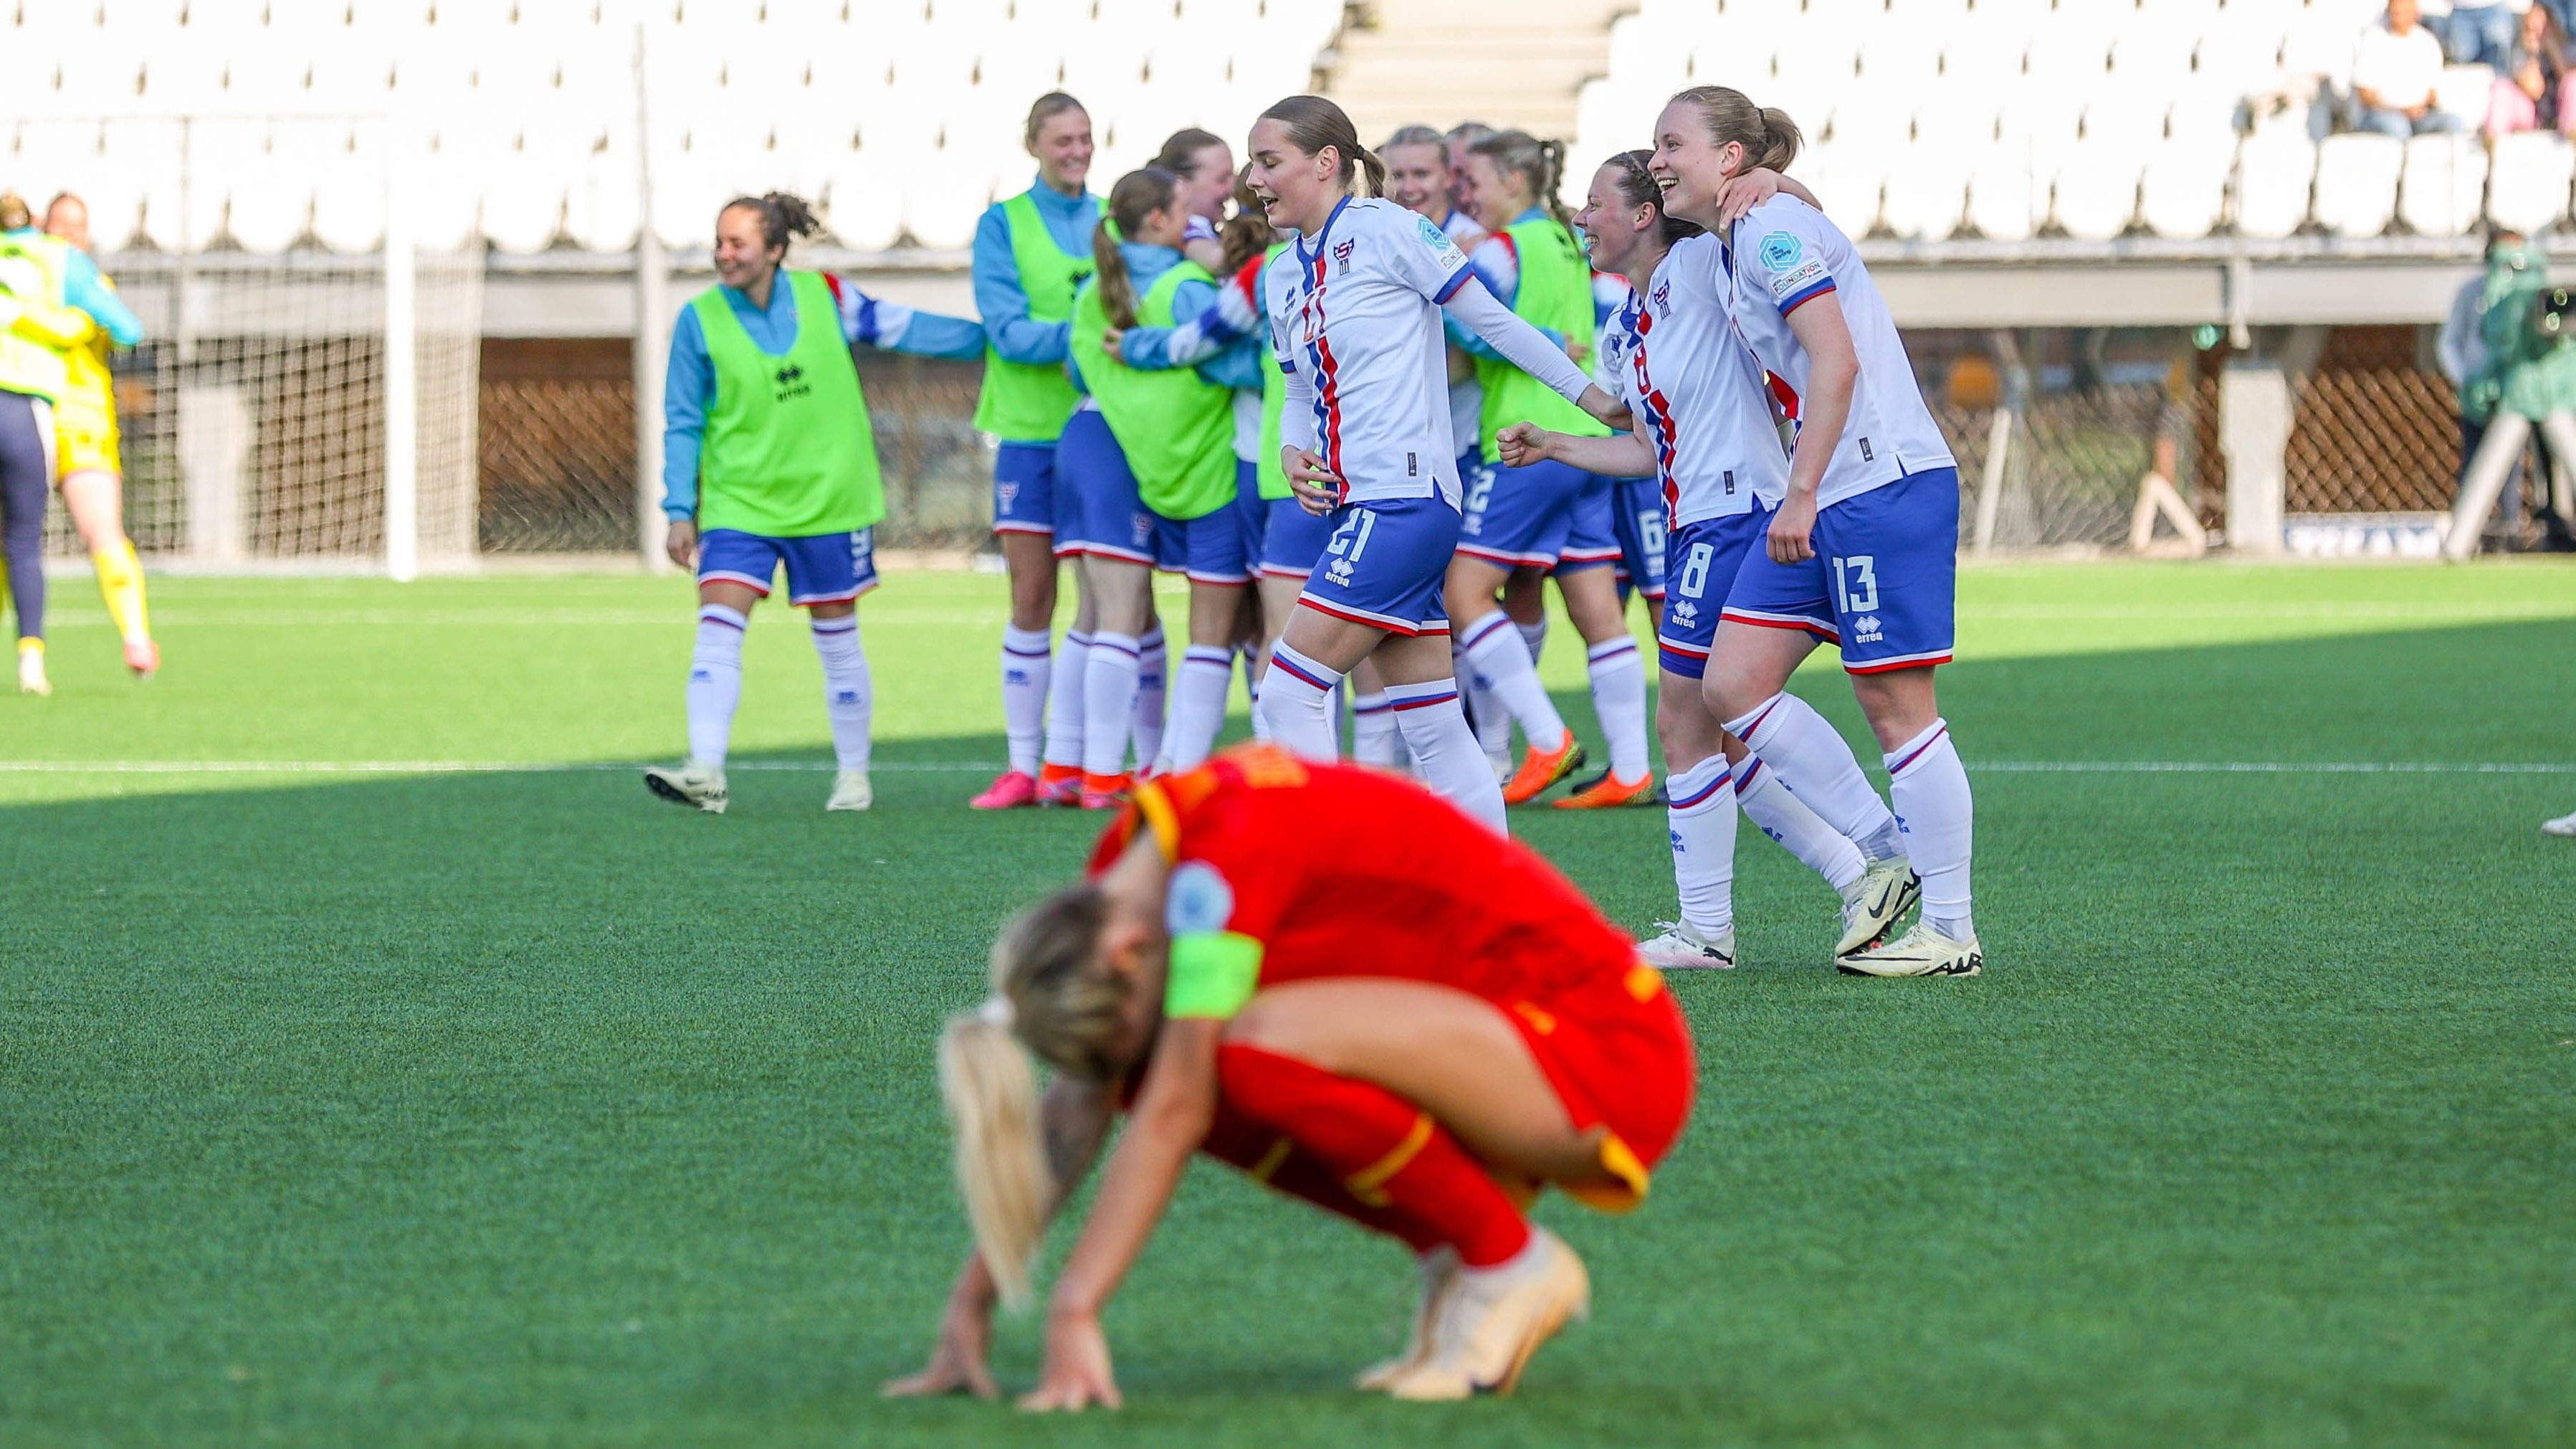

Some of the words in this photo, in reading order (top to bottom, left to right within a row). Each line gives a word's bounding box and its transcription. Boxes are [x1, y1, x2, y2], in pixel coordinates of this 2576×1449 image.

[1774, 262, 1821, 293] FOUNDATION
[1326, 508, 1377, 563] 21
[1638, 510, 1665, 556] 6
[1325, 571, 1350, 588] errea
[1679, 543, 1714, 599] 8
[1832, 556, 1879, 614] 13
[1671, 614, 1696, 630] errea
[1856, 632, 1884, 643] errea
